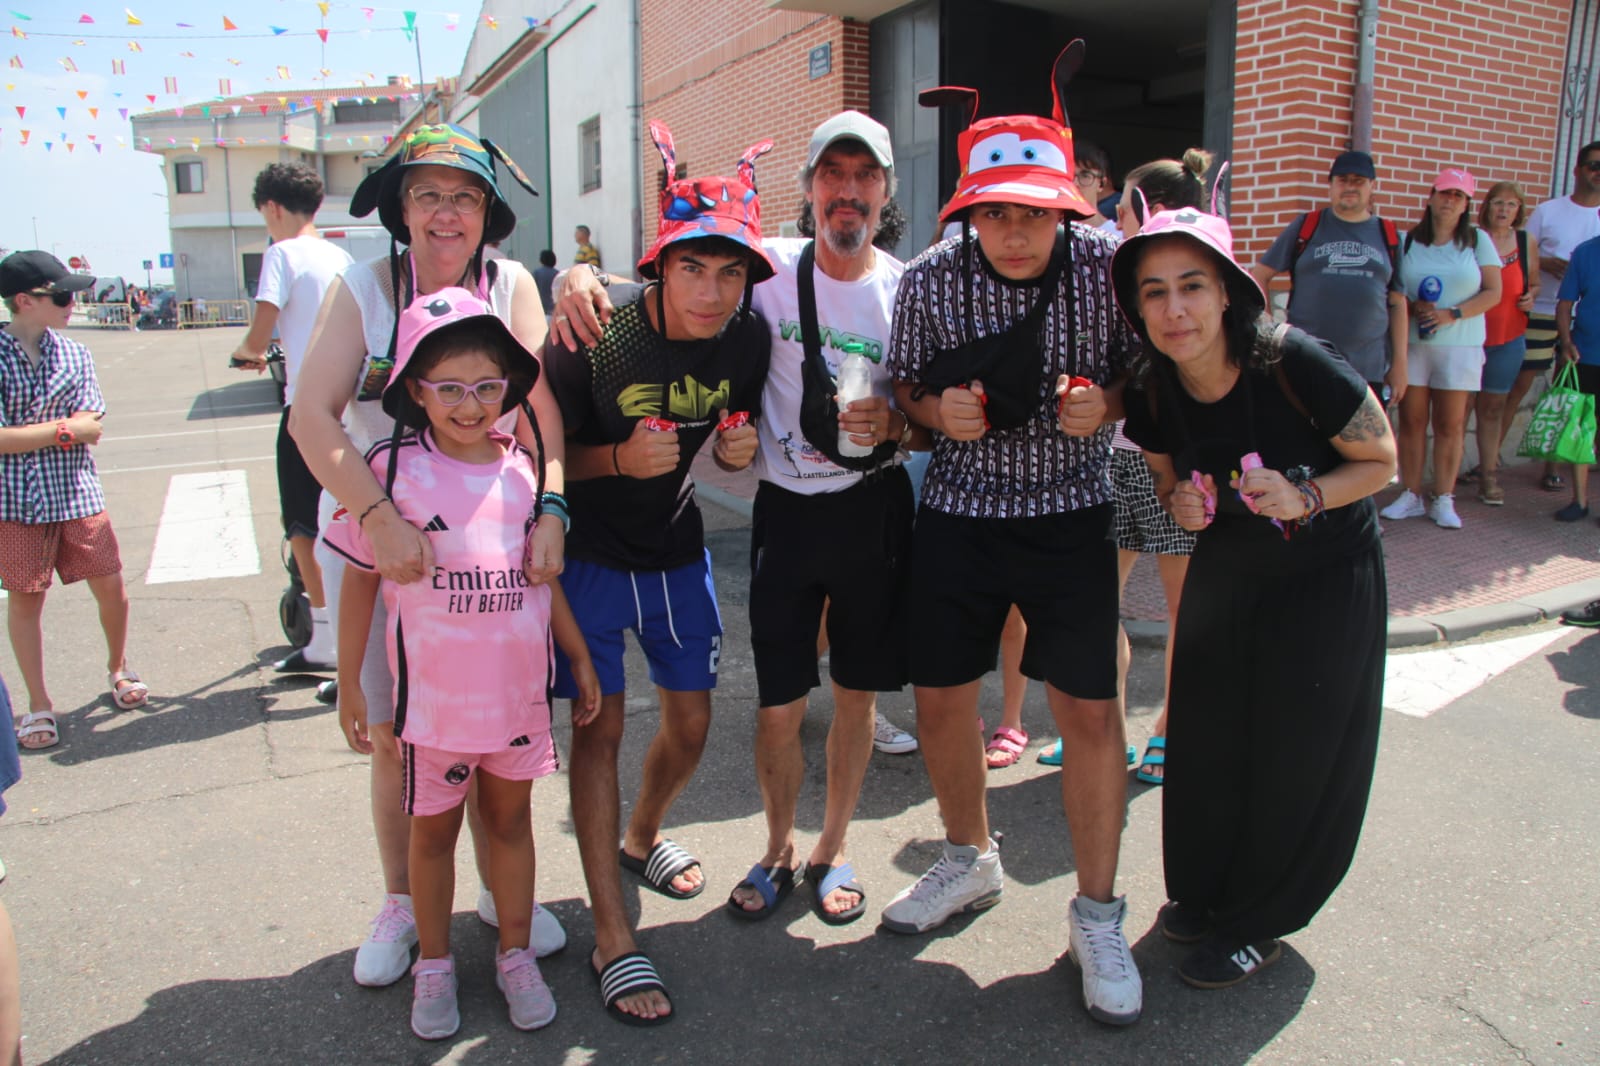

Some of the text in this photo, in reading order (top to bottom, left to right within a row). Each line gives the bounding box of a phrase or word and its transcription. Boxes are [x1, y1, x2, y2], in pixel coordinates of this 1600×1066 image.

[432, 564, 529, 590] Emirate
[448, 592, 524, 613] FLY BETTER
